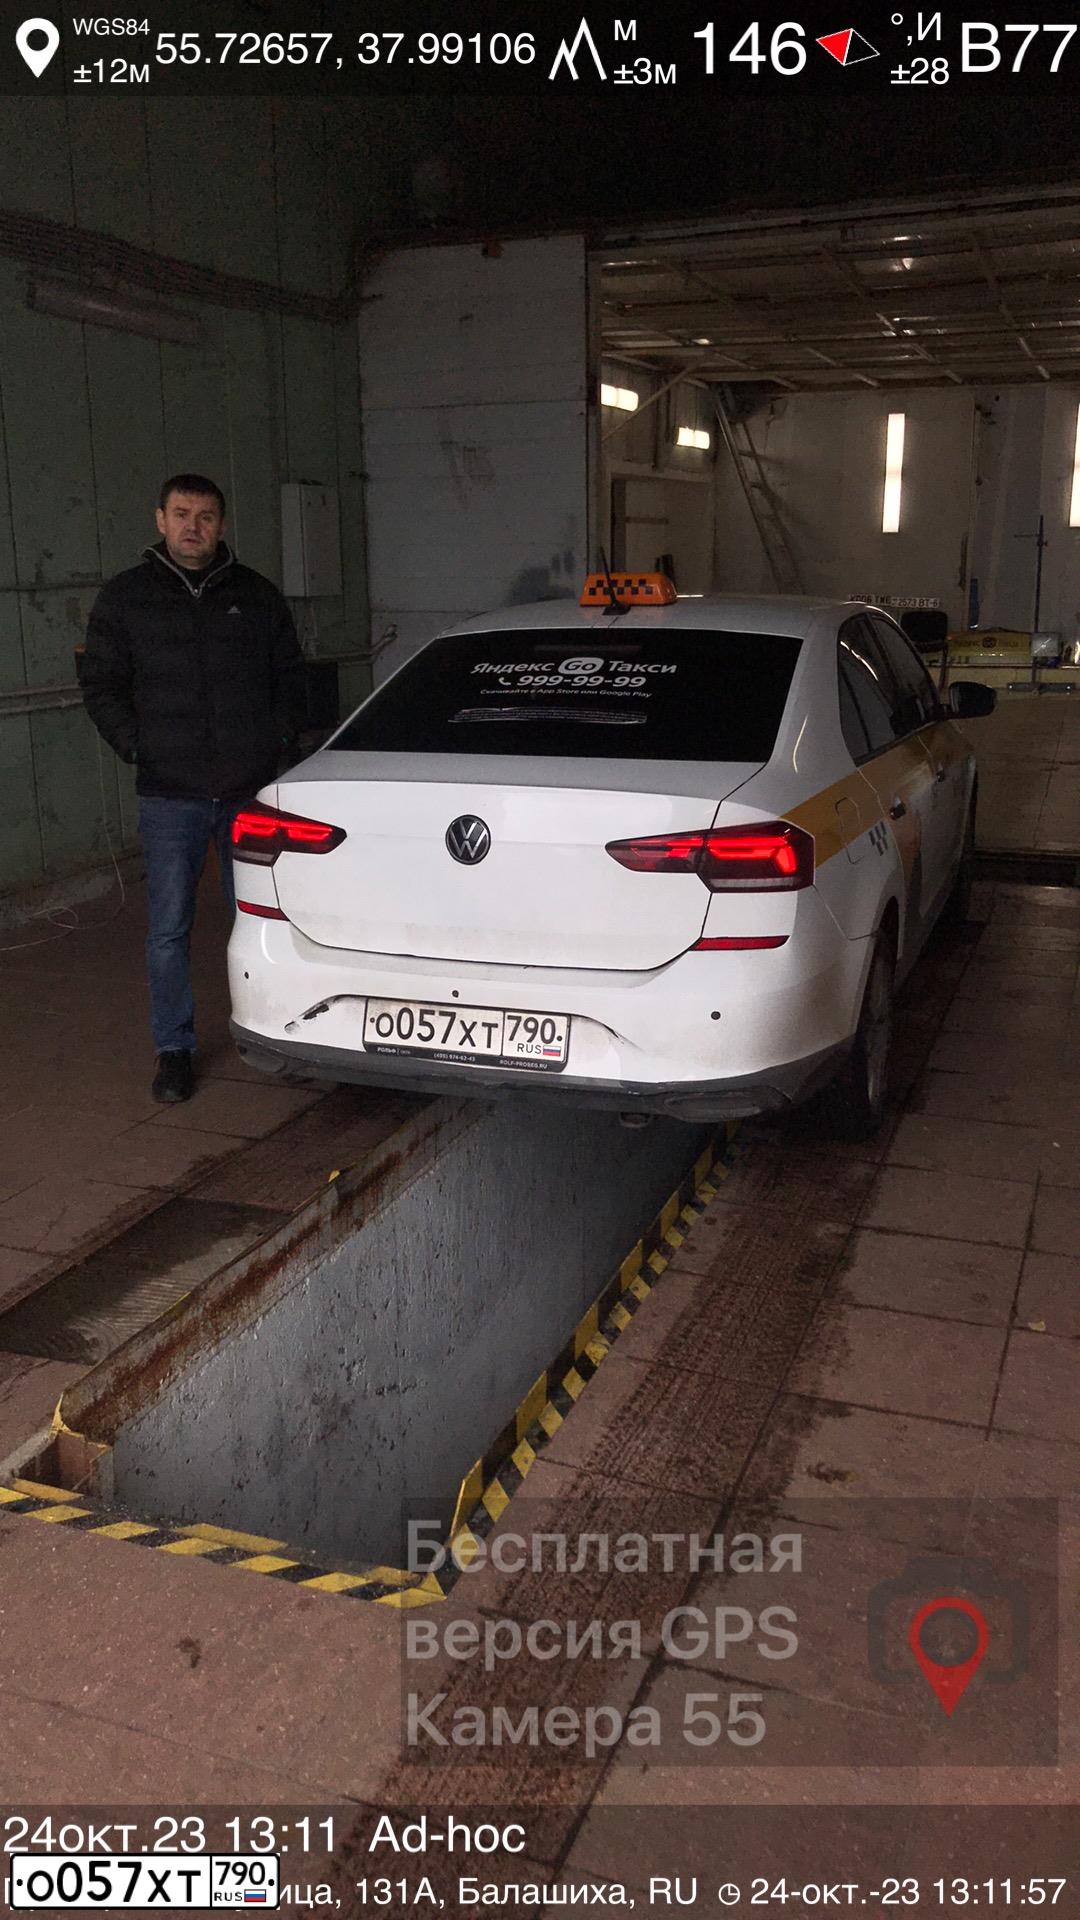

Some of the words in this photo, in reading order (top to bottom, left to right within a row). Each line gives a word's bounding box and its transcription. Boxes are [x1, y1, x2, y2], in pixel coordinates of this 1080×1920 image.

[470, 662, 555, 674] Яндекс
[608, 660, 677, 673] Такси
[517, 675, 647, 688] 999-99-99
[538, 688, 555, 696] App
[599, 689, 630, 697] Google
[506, 1015, 556, 1045] 790
[516, 1043, 542, 1055] RUS
